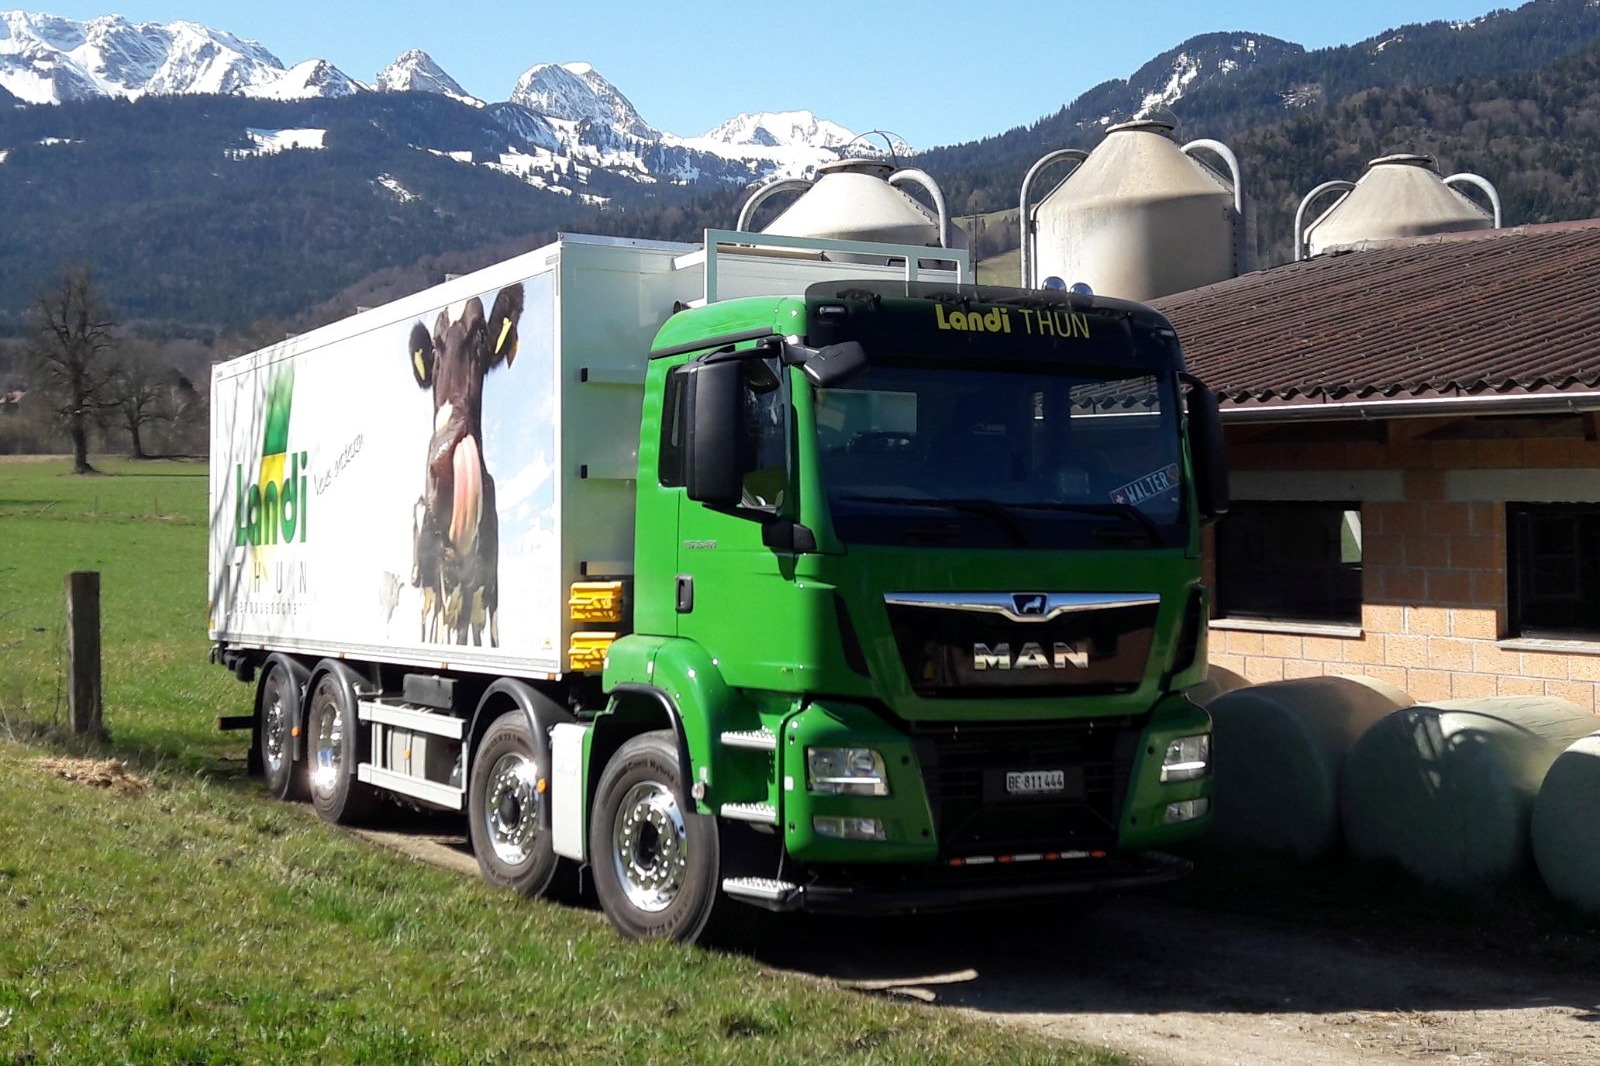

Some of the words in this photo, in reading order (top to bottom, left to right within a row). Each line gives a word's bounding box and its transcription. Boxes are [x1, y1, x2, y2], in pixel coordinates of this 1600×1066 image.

[934, 303, 1011, 333] Landi
[1018, 308, 1090, 339] THUN
[1124, 471, 1170, 504] WALTER
[973, 641, 1089, 670] MAN
[1008, 775, 1021, 789] BE
